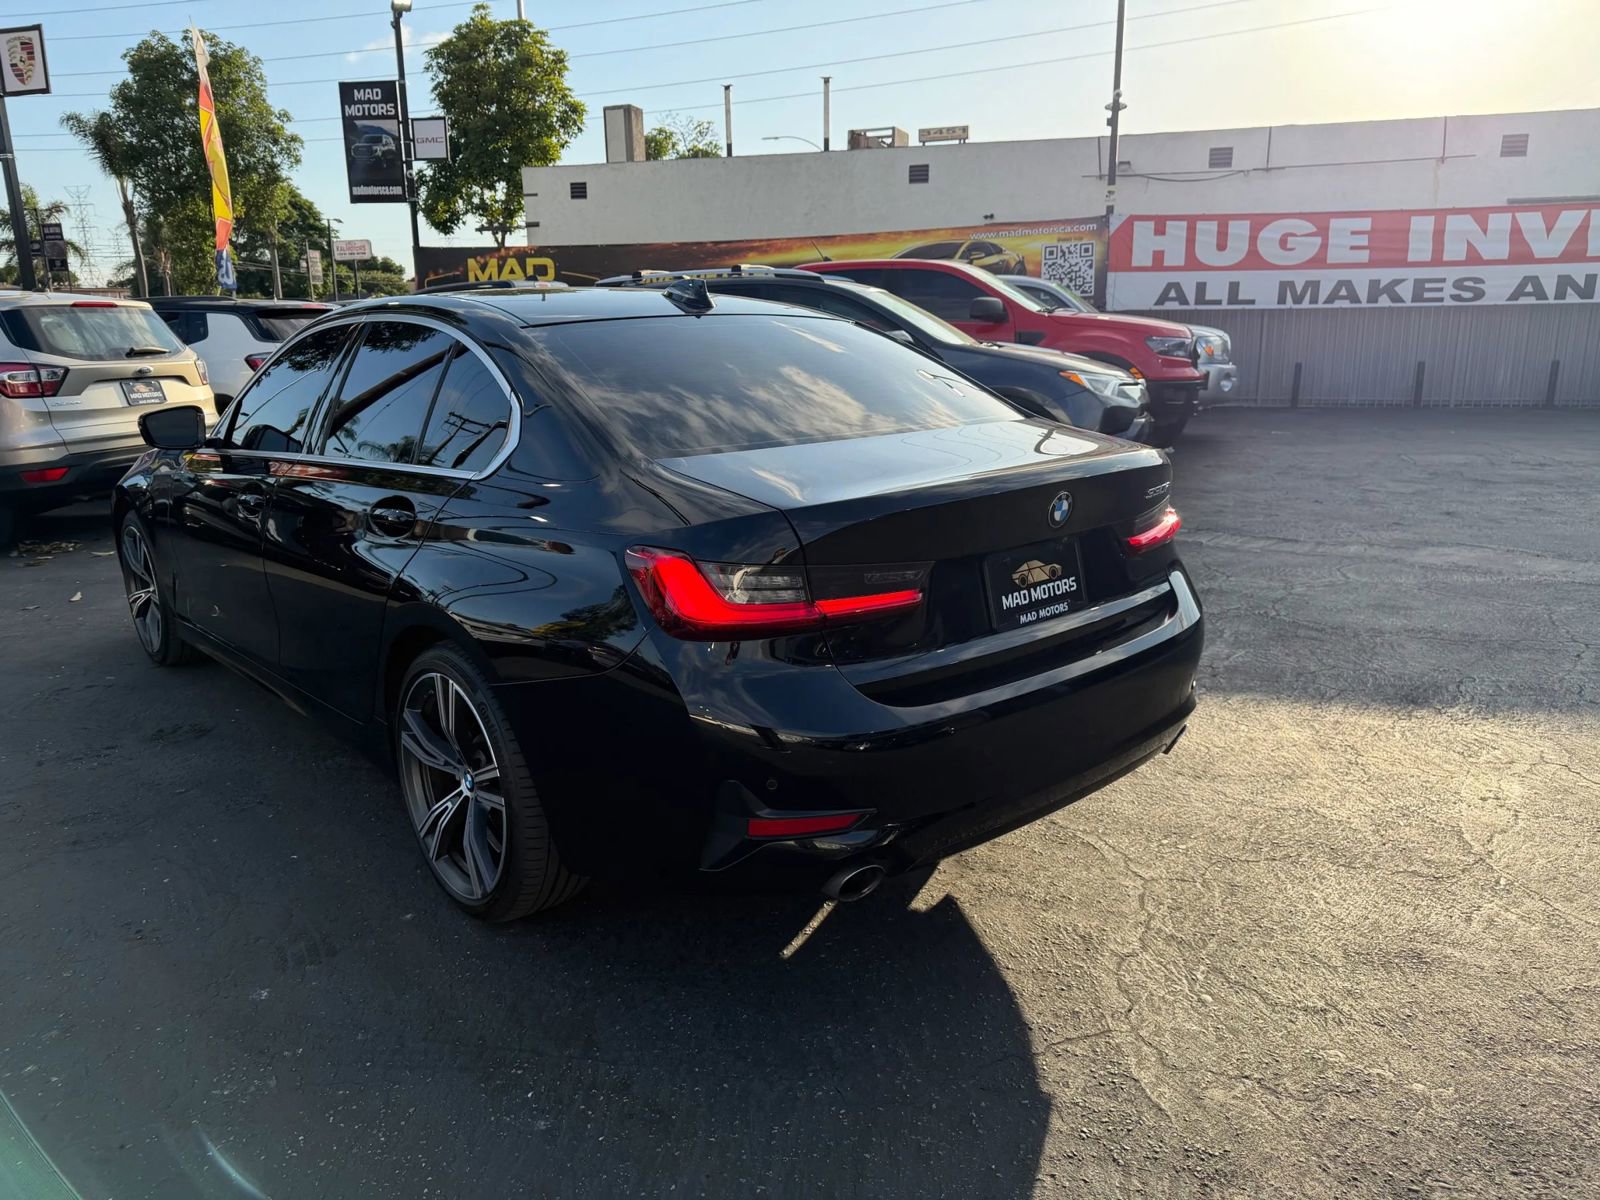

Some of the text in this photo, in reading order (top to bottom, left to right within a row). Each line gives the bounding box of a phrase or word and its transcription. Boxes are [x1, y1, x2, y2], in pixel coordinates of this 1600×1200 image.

[353, 88, 382, 101] MAD
[344, 103, 396, 117] MOTORS
[416, 136, 444, 145] GMC
[969, 222, 1097, 240] www.madmotorsca.com
[1131, 217, 1372, 267] HUGE
[467, 257, 555, 283] MAD
[1153, 272, 1599, 307] ALL MAKES AN
[1001, 576, 1077, 611] MAD MOTORS
[1019, 601, 1069, 625] MAD MOTORS
